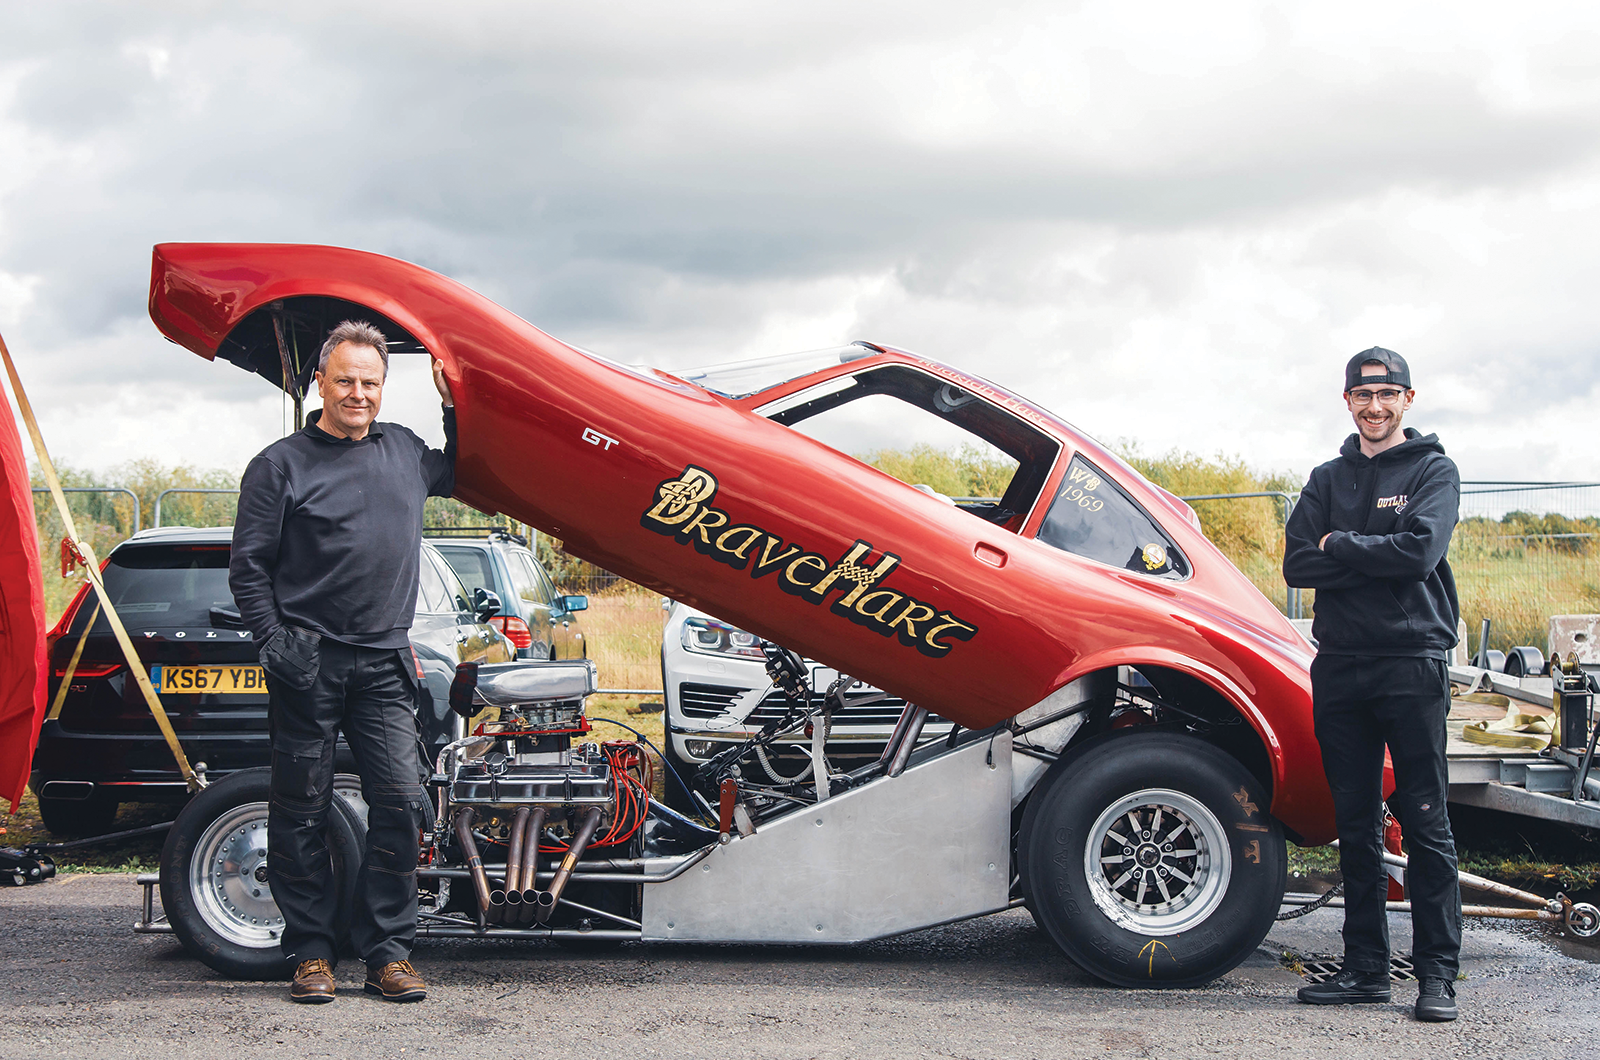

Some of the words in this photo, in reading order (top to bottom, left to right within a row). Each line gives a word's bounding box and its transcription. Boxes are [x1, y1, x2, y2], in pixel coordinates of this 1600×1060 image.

[581, 427, 620, 451] GT
[1069, 467, 1101, 492] WB
[1061, 485, 1104, 512] 1969
[643, 465, 977, 654] BraveHart
[166, 669, 223, 689] KS67
[1052, 825, 1083, 920] DRAG
